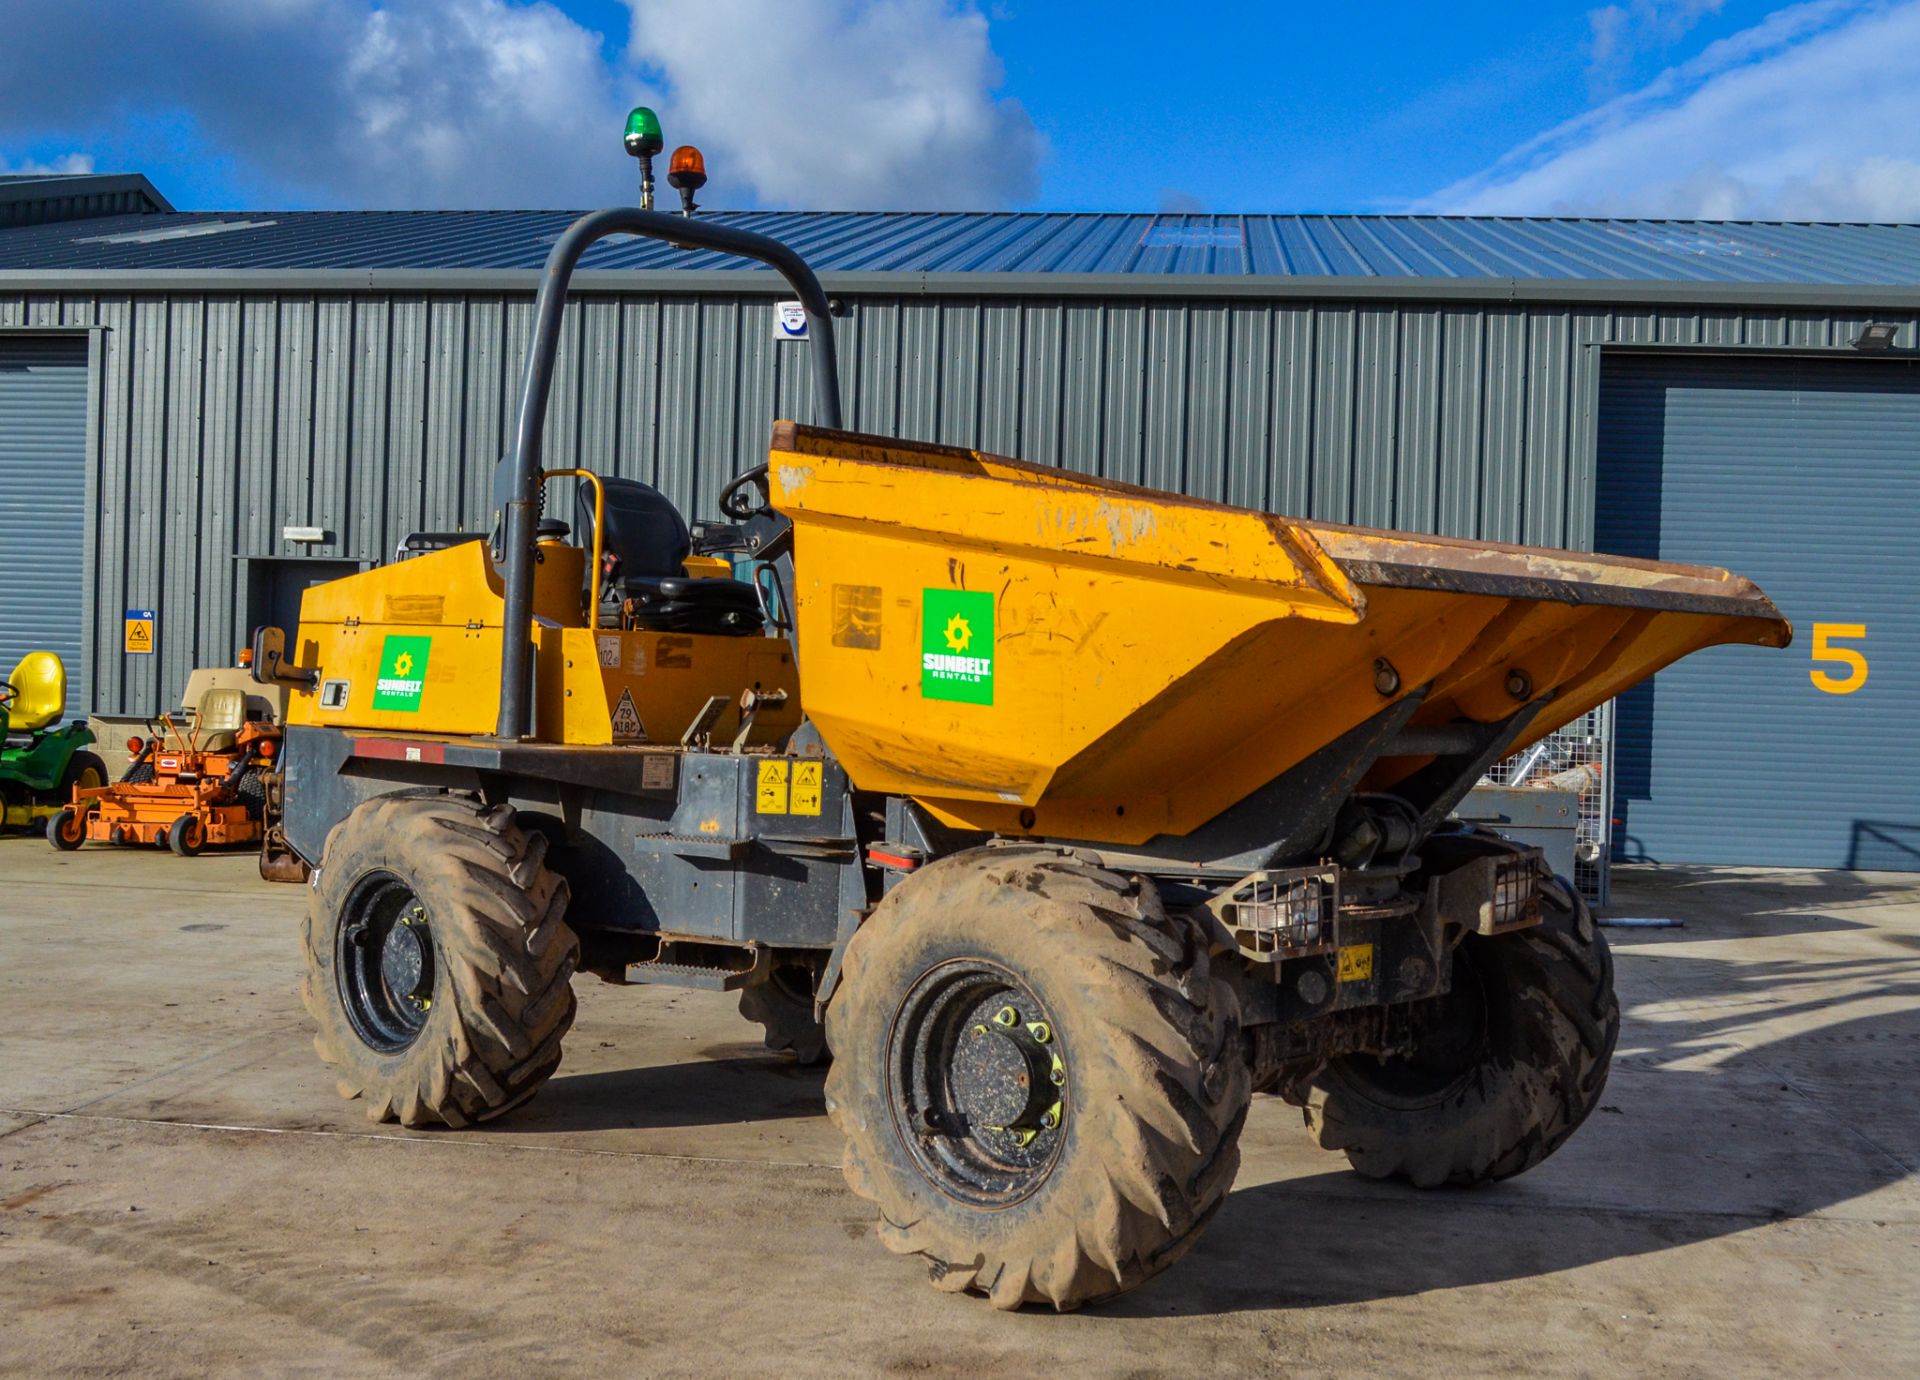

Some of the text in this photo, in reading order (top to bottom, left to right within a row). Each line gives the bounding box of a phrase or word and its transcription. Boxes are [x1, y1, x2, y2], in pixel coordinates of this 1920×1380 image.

[600, 649, 613, 667] 102
[923, 653, 991, 675] SUNBELT
[1809, 623, 1869, 695] 5
[932, 670, 981, 682] RENTALS
[376, 678, 422, 693] SUNBELT
[381, 690, 414, 698] RENTALS
[620, 708, 632, 720] 79
